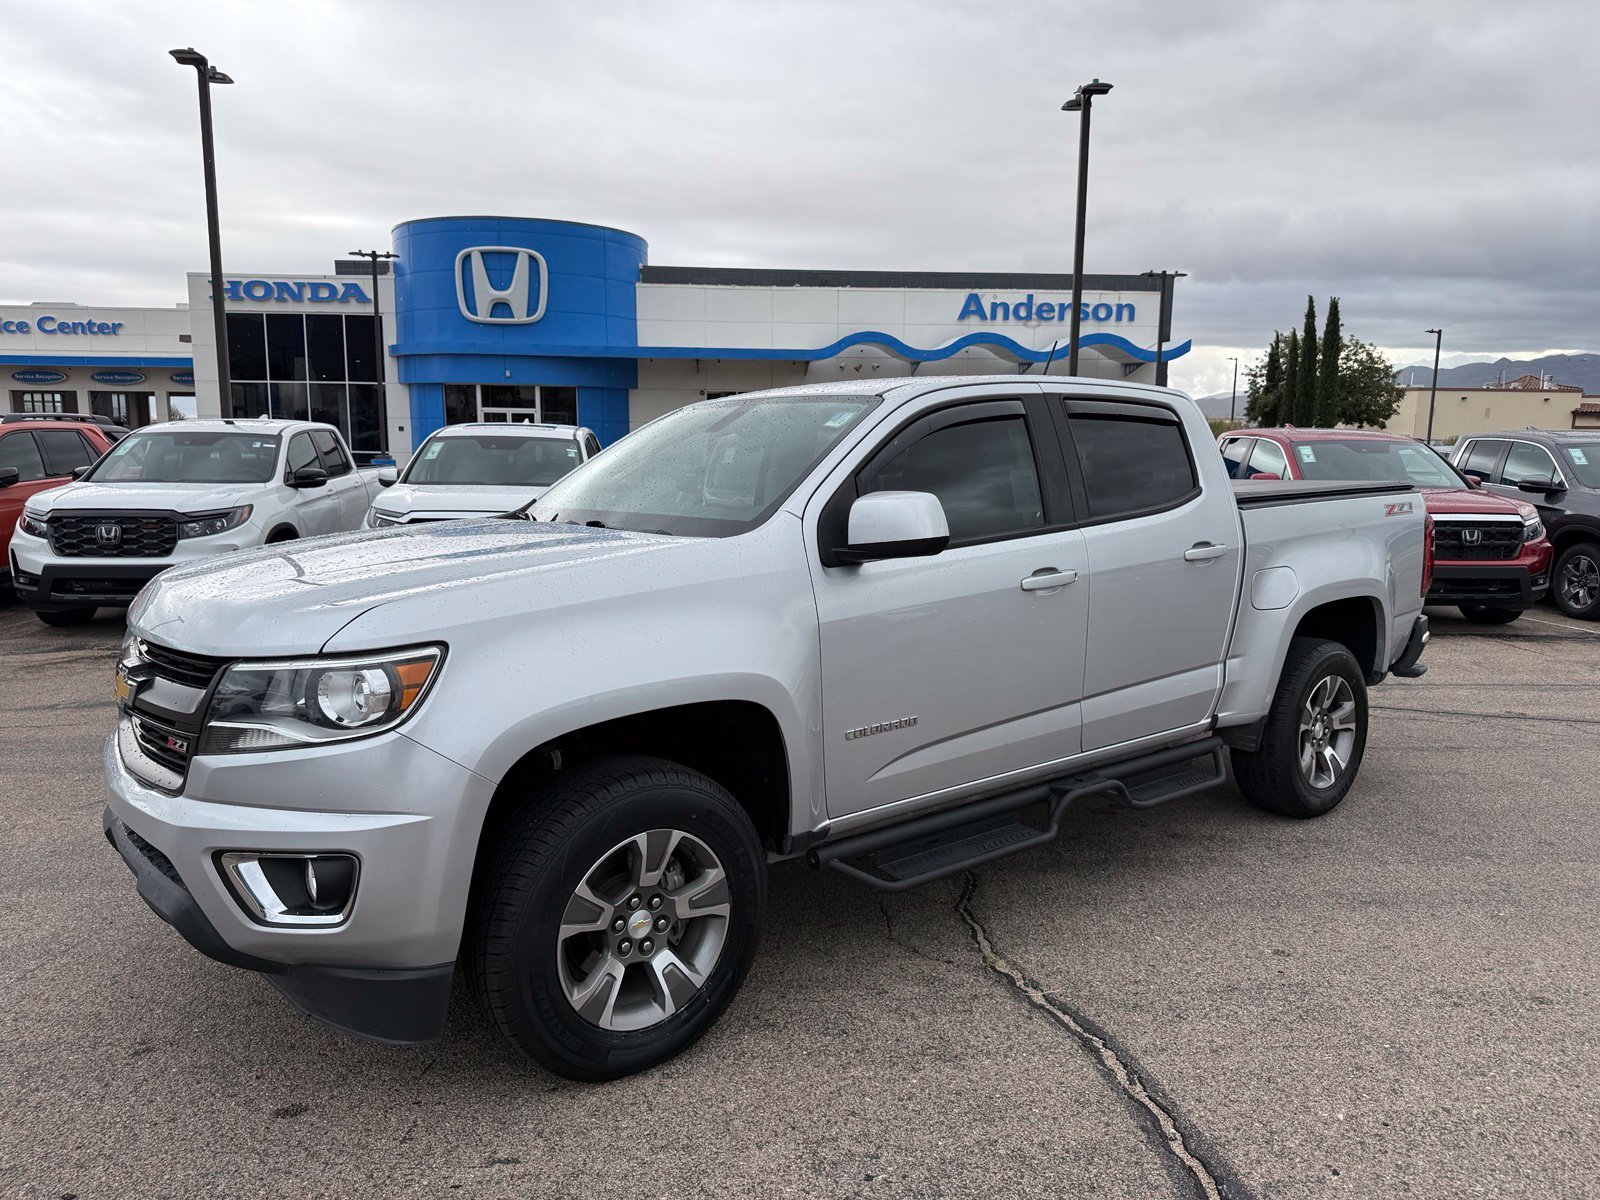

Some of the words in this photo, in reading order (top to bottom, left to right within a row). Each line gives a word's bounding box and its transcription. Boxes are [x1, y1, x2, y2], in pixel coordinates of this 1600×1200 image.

[208, 280, 372, 303] HONDA
[957, 293, 1136, 322] Anderson
[37, 315, 124, 335] Center
[1384, 502, 1413, 517] Z71
[846, 715, 919, 740] COLORADO
[167, 737, 187, 753] Z71
